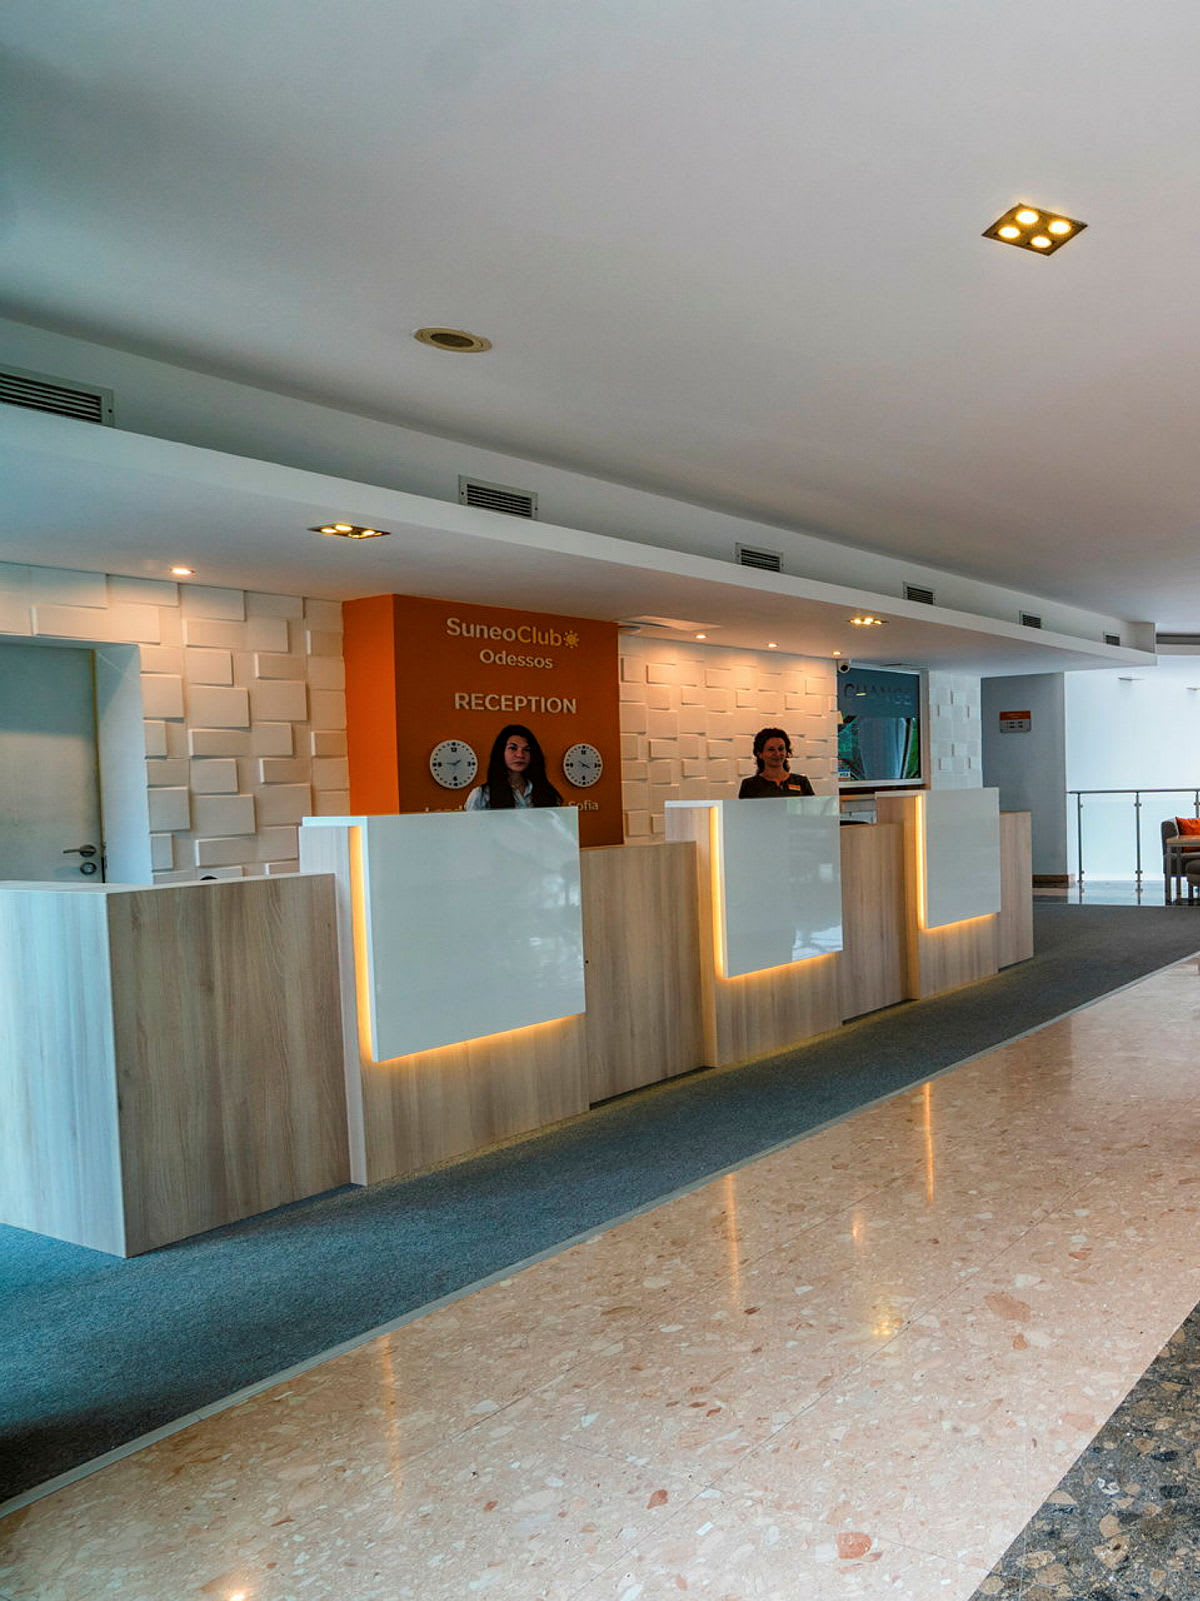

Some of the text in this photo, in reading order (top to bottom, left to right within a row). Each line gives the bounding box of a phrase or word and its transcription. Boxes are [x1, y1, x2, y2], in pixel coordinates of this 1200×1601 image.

[447, 617, 562, 647] SuneoClub
[479, 649, 554, 669] Odessos
[454, 692, 578, 714] RECEPTION
